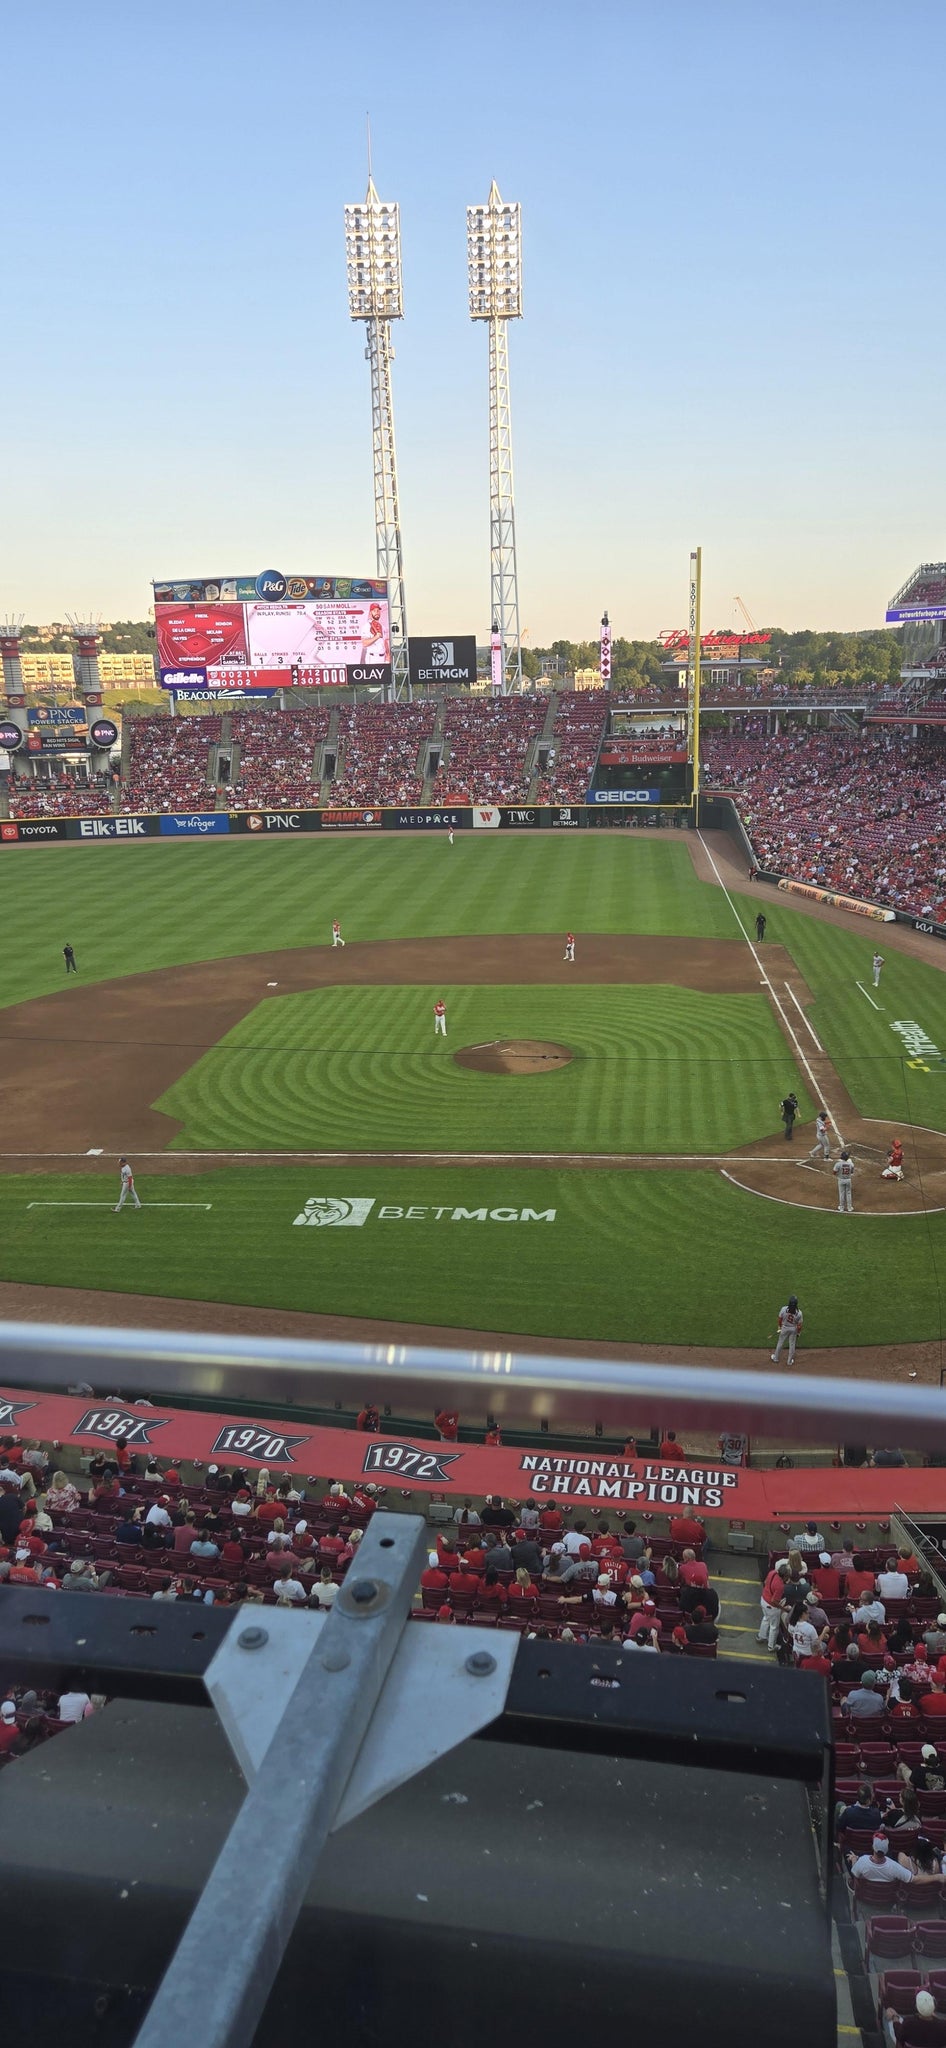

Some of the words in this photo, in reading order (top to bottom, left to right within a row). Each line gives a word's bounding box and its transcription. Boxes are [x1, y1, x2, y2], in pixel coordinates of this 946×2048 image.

[263, 580, 284, 592] P&G
[290, 584, 306, 595] Tide
[164, 672, 204, 684] Gillette
[353, 669, 384, 680] OLAY
[418, 668, 469, 679] BETMGM
[177, 690, 217, 700] BEACON
[50, 709, 76, 719] PNC
[595, 790, 650, 802] GEICO
[265, 815, 301, 828] PNC
[322, 811, 382, 822] CHAMPION
[400, 814, 458, 824] MEDPACE
[480, 812, 493, 822] W
[508, 810, 535, 821] TWC
[21, 826, 58, 834] TOYOTA
[80, 818, 145, 836] Elk+Elk
[188, 817, 215, 831] Kroger
[889, 1020, 942, 1057] TriHealth
[378, 1206, 557, 1222] BETMGM
[84, 1413, 146, 1440] 1961
[226, 1429, 286, 1458] 1970
[728, 1439, 741, 1450] 30
[374, 1446, 438, 1476] 1972
[522, 1456, 636, 1479] NATIONAL
[646, 1466, 737, 1488] LEAGUE
[531, 1474, 723, 1508] CHAMPIONS
[608, 1568, 618, 1581] 21
[795, 1634, 804, 1644] 44
